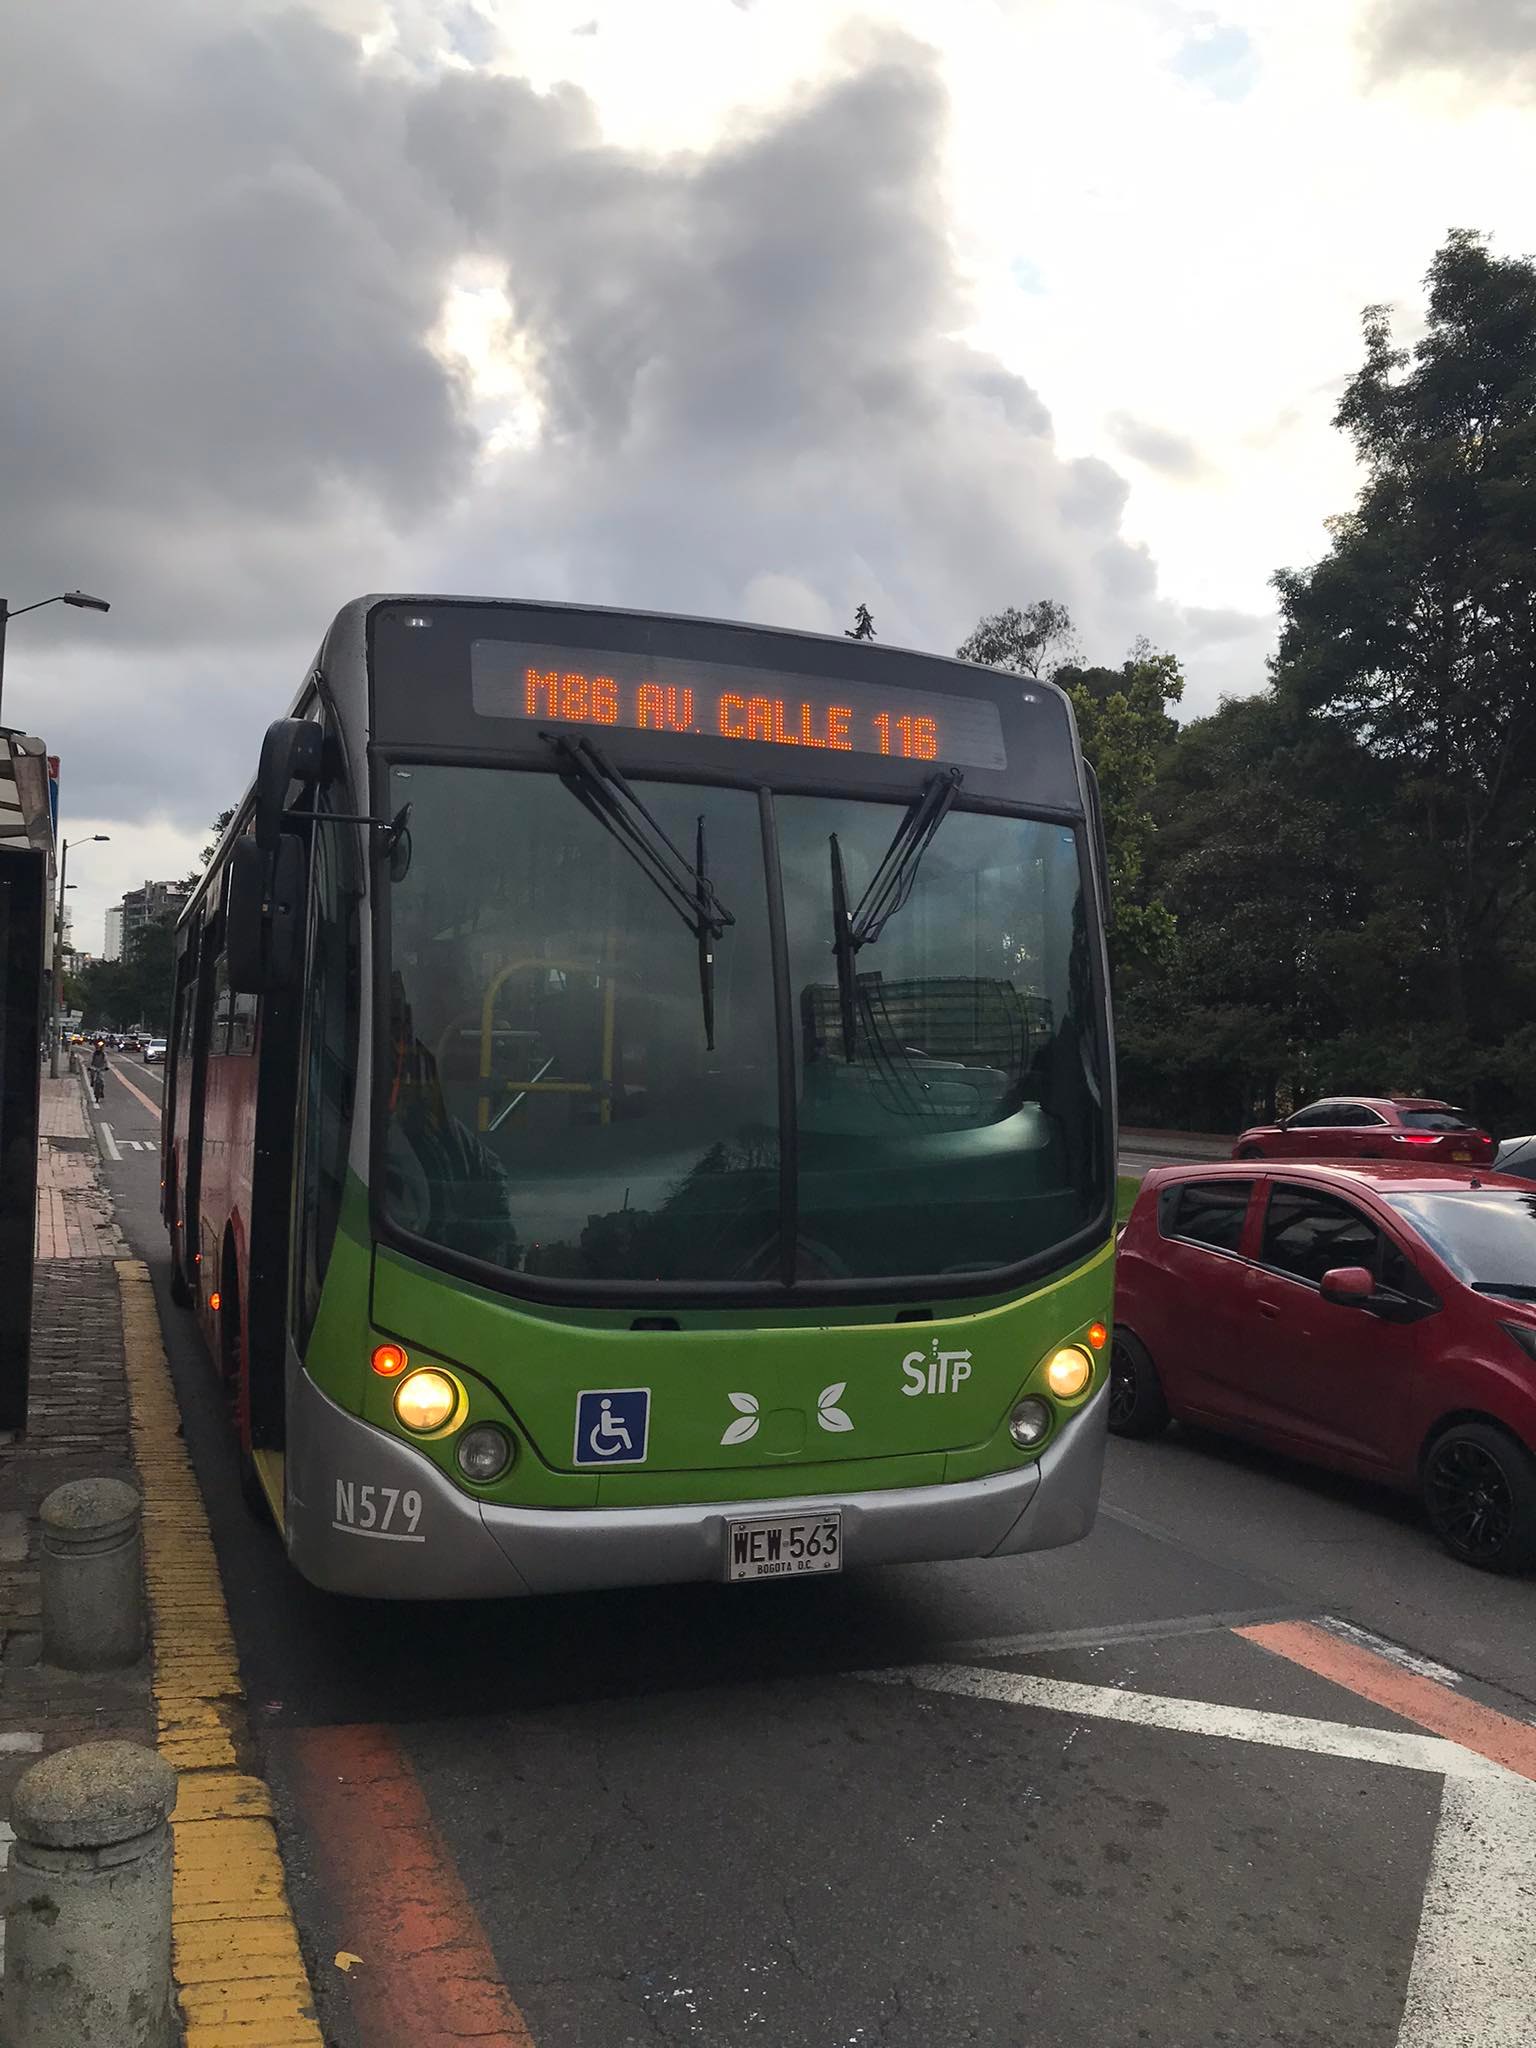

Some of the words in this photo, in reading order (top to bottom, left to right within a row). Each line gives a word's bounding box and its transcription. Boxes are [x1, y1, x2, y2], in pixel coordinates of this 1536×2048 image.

[527, 668, 618, 724] M86
[639, 683, 701, 733] AV.
[720, 693, 853, 751] CALLE
[873, 712, 937, 760] 116
[336, 1479, 423, 1533] N579
[757, 1561, 792, 1575] BOGOTA
